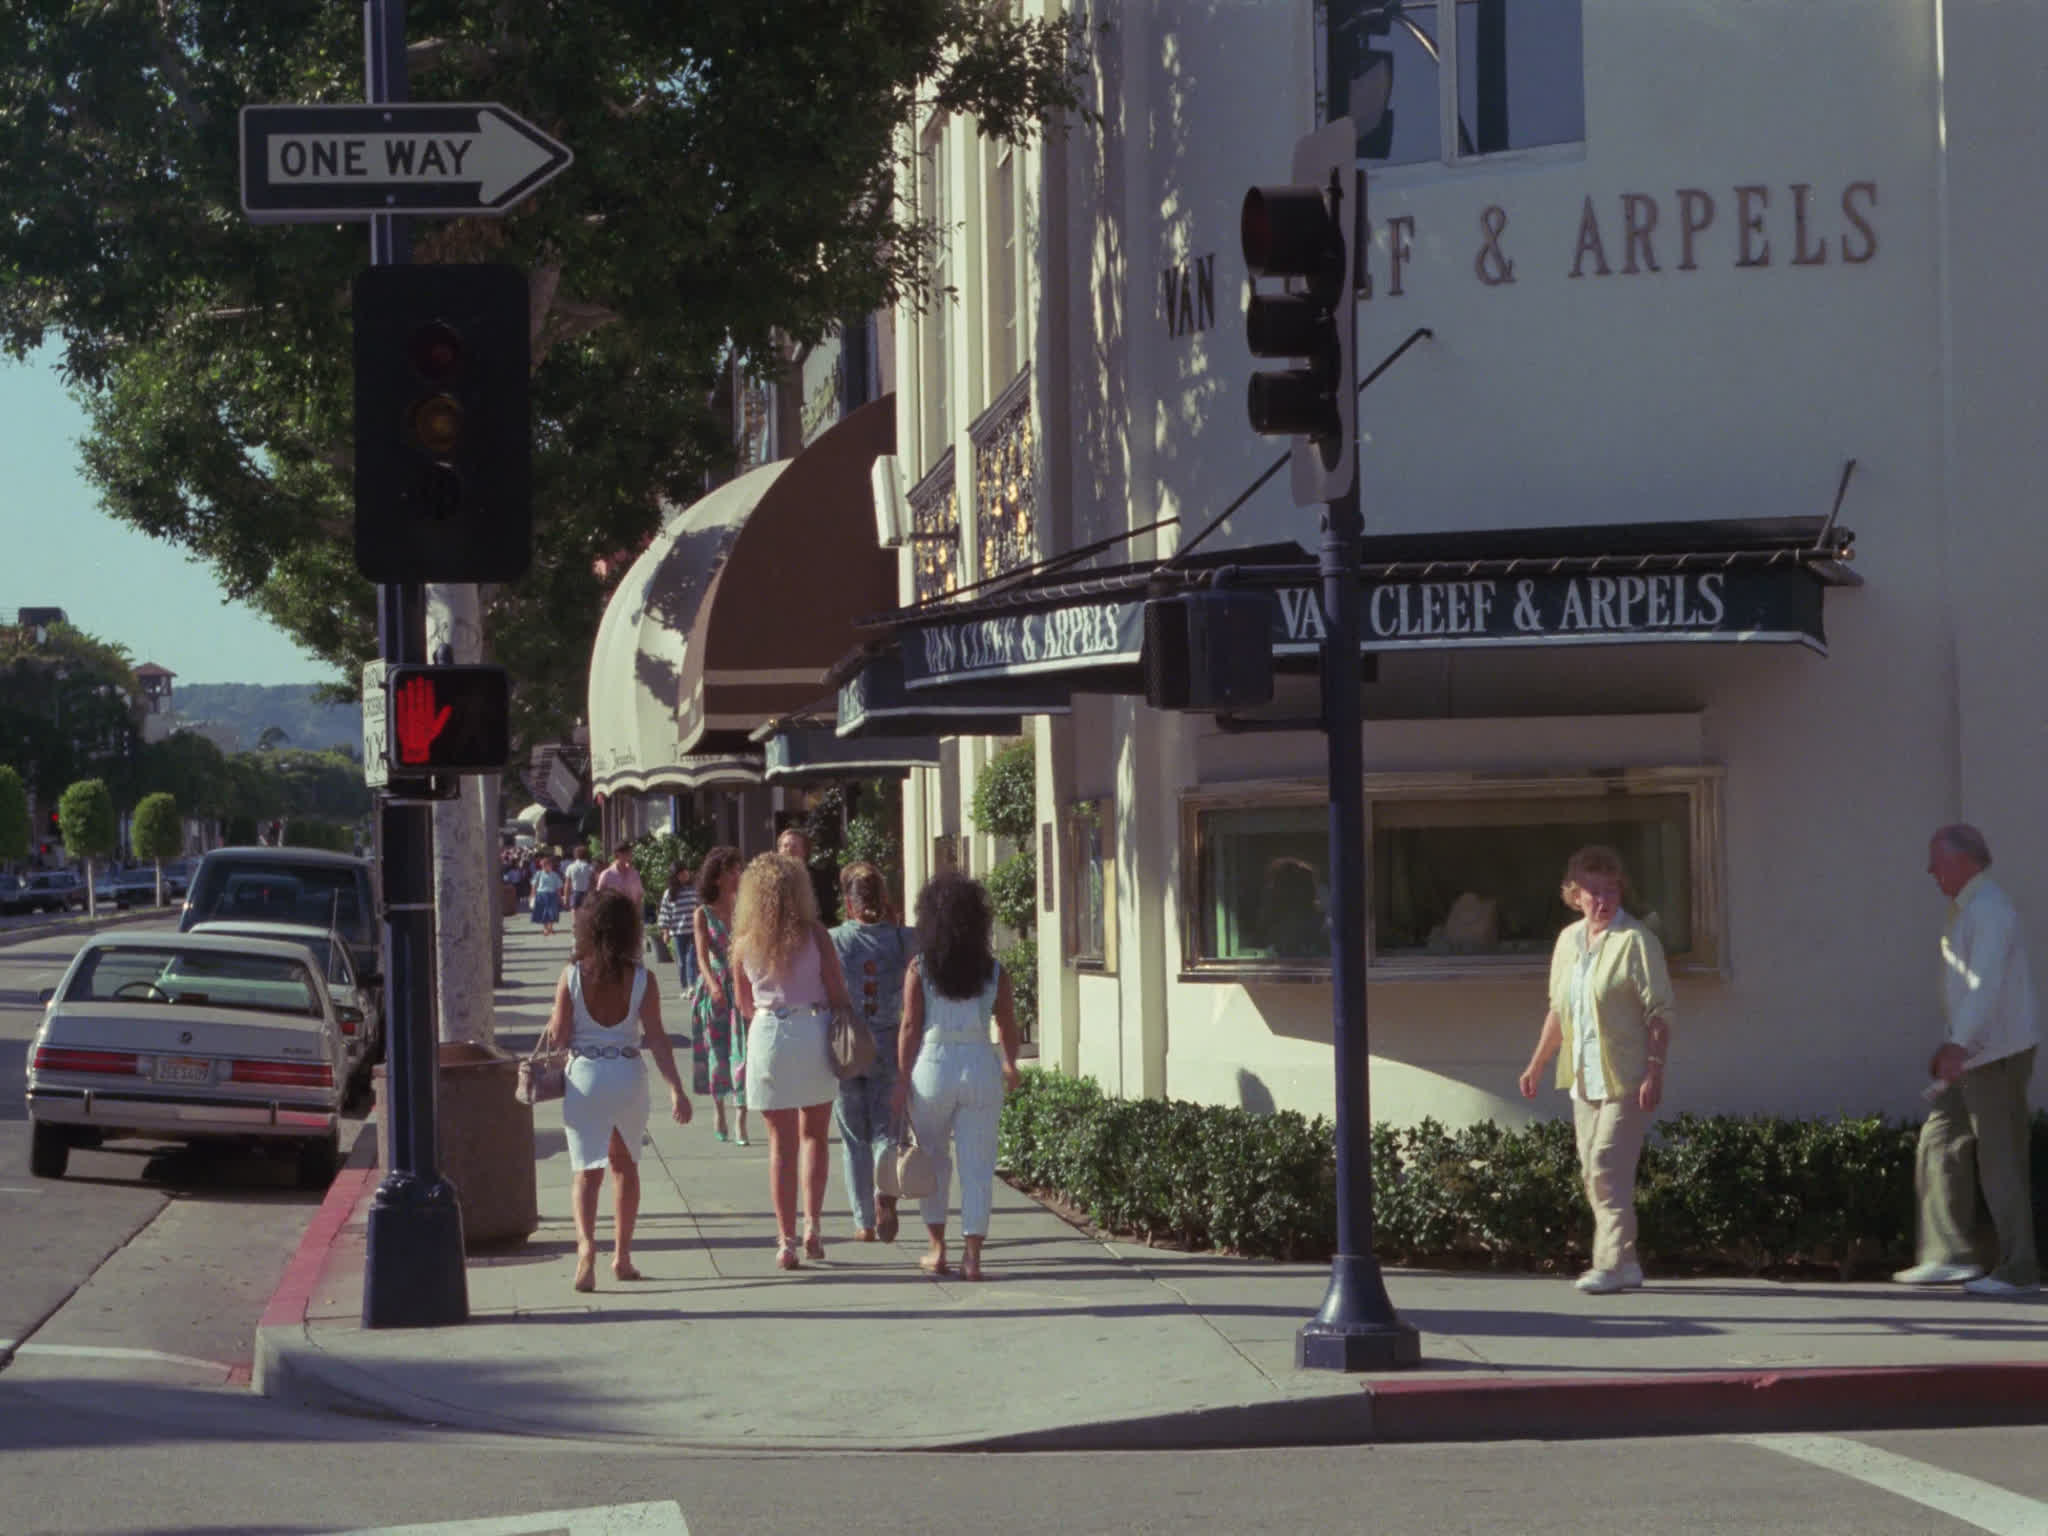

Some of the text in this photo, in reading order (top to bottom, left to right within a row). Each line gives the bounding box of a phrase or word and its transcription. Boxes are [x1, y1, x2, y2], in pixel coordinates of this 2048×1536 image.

[280, 139, 473, 177] ONE WAY
[1163, 253, 1215, 341] VAN
[1474, 205, 1516, 286] &
[1568, 180, 1878, 279] ARPELS
[922, 624, 956, 673] VAN
[1021, 614, 1036, 662] &
[1042, 603, 1121, 658] ARPELS
[1275, 573, 1725, 638] VA CLEEF & ARPELS
